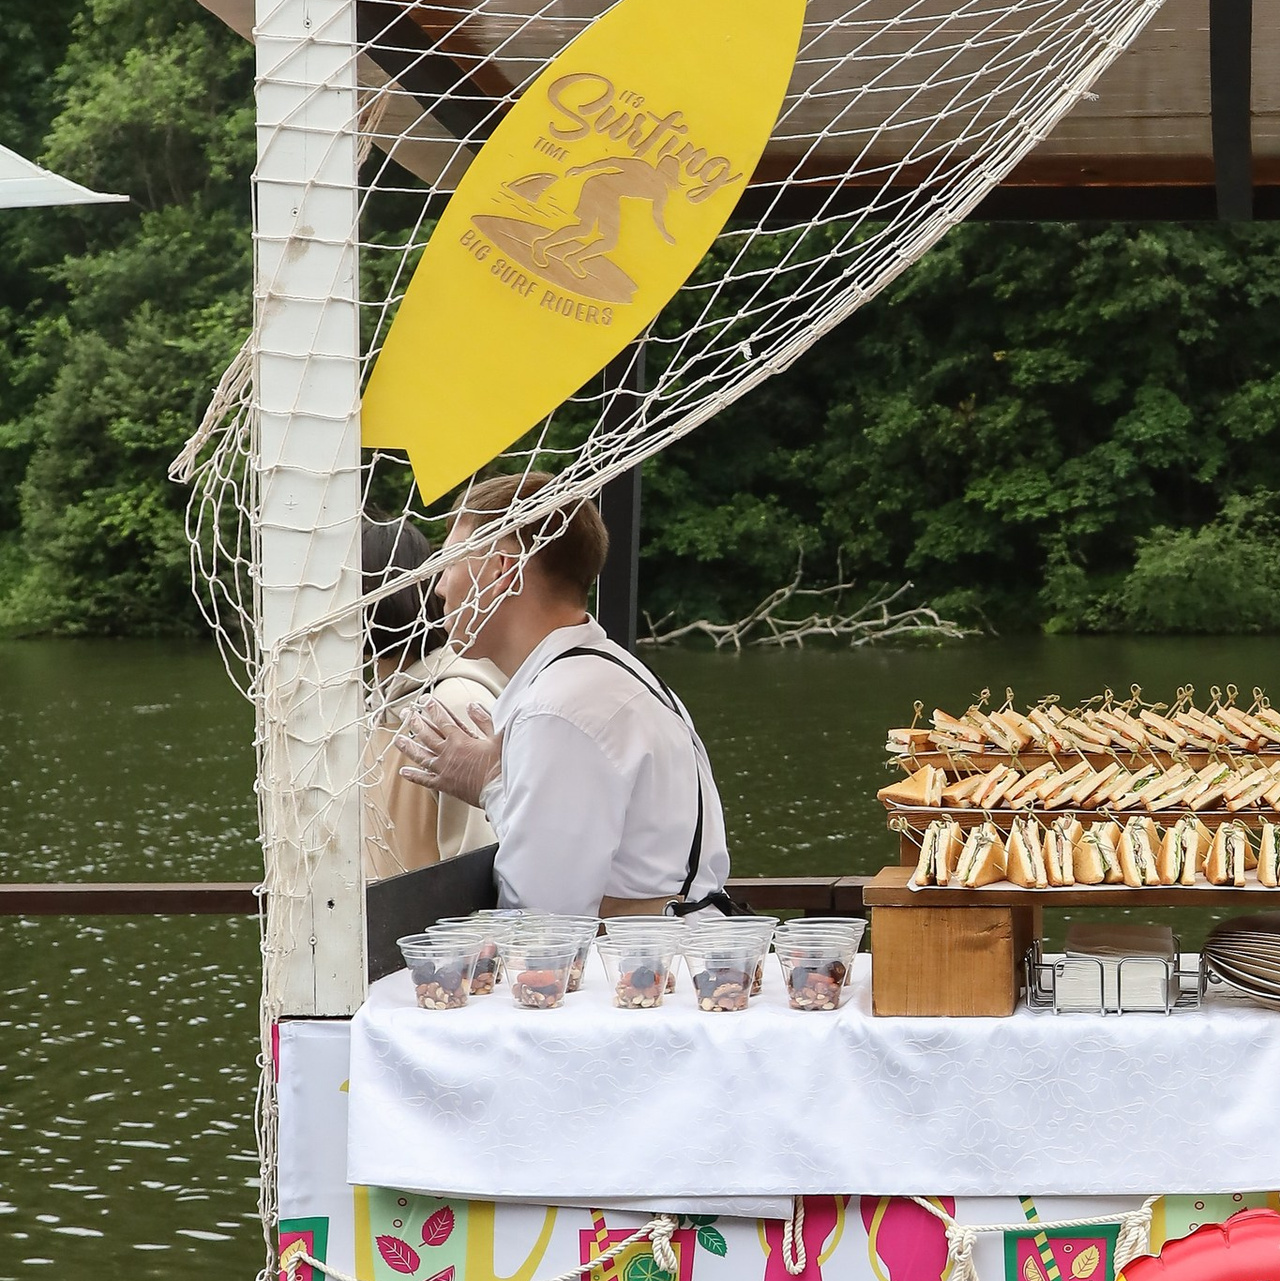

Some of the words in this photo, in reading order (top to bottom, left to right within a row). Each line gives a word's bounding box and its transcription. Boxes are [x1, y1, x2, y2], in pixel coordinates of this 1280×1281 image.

[618, 89, 646, 109] ITS
[532, 136, 571, 164] TIME
[547, 72, 743, 204] Surfing
[459, 229, 492, 262] BIG
[490, 258, 539, 298] SURF
[539, 289, 614, 326] RIDERS
